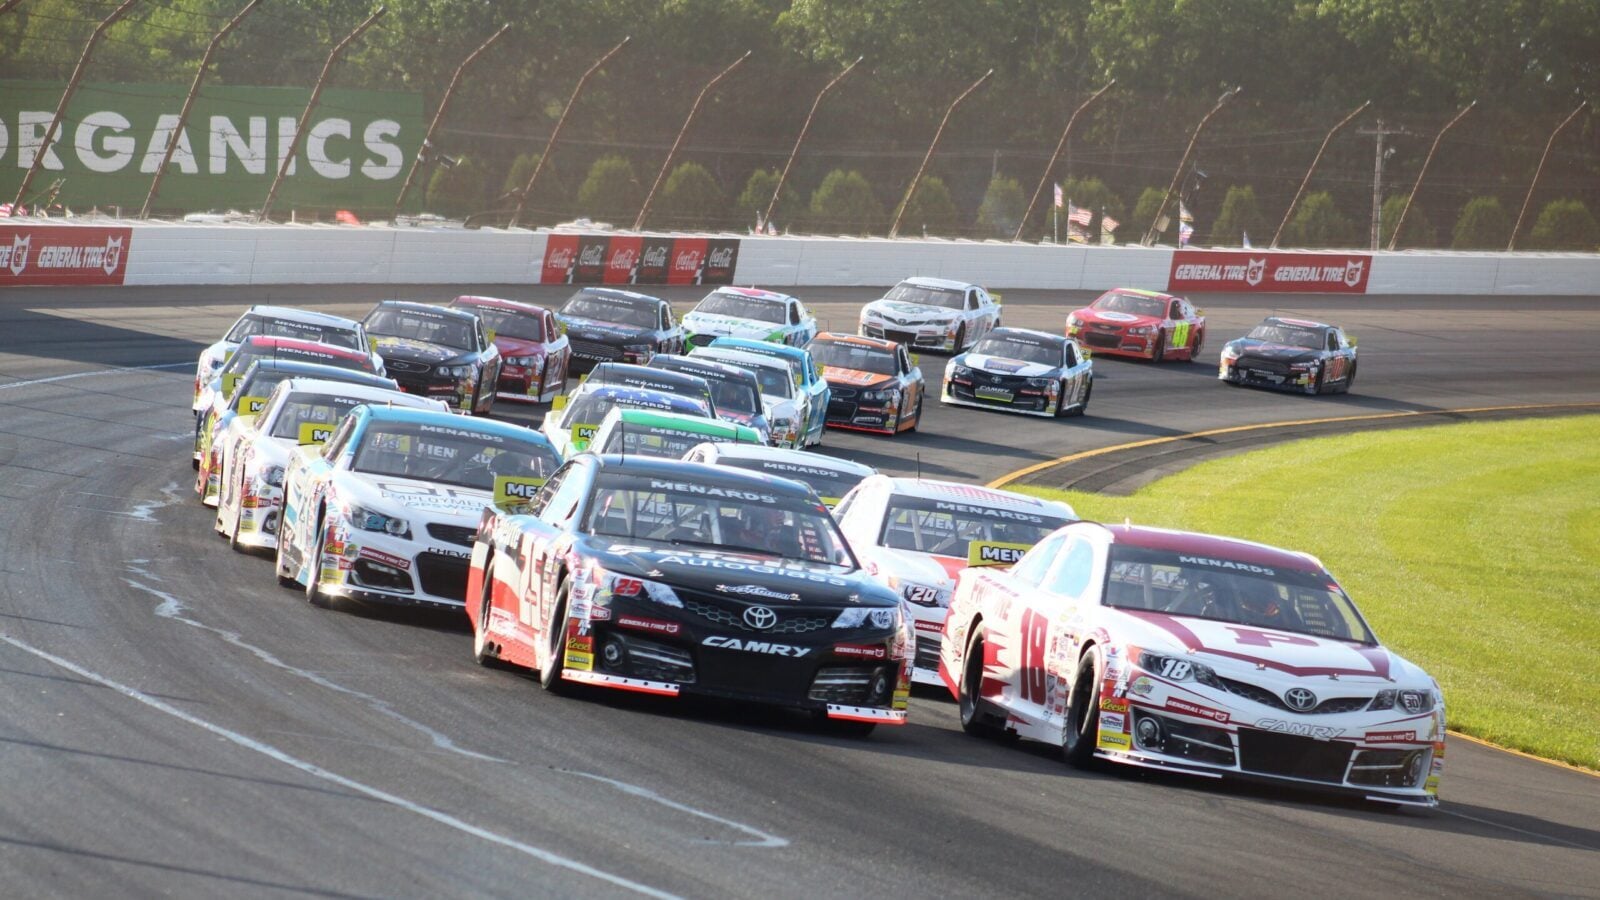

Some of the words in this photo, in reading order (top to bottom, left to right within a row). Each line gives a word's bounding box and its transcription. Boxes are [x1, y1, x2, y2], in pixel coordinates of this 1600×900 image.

[0, 110, 404, 181] RGANICS
[38, 246, 82, 268] GENERAL
[82, 246, 106, 268] TIRE
[1175, 264, 1221, 280] GENERAL
[1222, 265, 1247, 280] TIRE
[1274, 266, 1320, 282] GENERAL
[1321, 267, 1345, 282] TIRE
[277, 346, 334, 359] MENARDS
[680, 366, 727, 379] MENARDS
[616, 398, 672, 411] MENARDS
[420, 425, 504, 444] MENARDS
[650, 427, 733, 444] MENARDS
[763, 462, 840, 478] MENARDS
[651, 481, 777, 504] MENARDS
[936, 502, 1043, 524] MENARDS
[360, 549, 386, 560] GENERAL
[658, 555, 847, 587] AutoGlass
[1179, 555, 1276, 576] MENARDS
[614, 579, 643, 596] 25
[910, 586, 938, 602] 20
[619, 618, 649, 628] GENERAL
[649, 622, 666, 630] TIRE
[702, 636, 811, 658] CAMRY
[835, 647, 861, 655] GENERAL
[1021, 607, 1049, 705] 18
[1161, 659, 1191, 680] 18
[1167, 700, 1198, 714] GENERAL
[1199, 708, 1215, 718] TIRE
[1254, 717, 1347, 739] CAMRY
